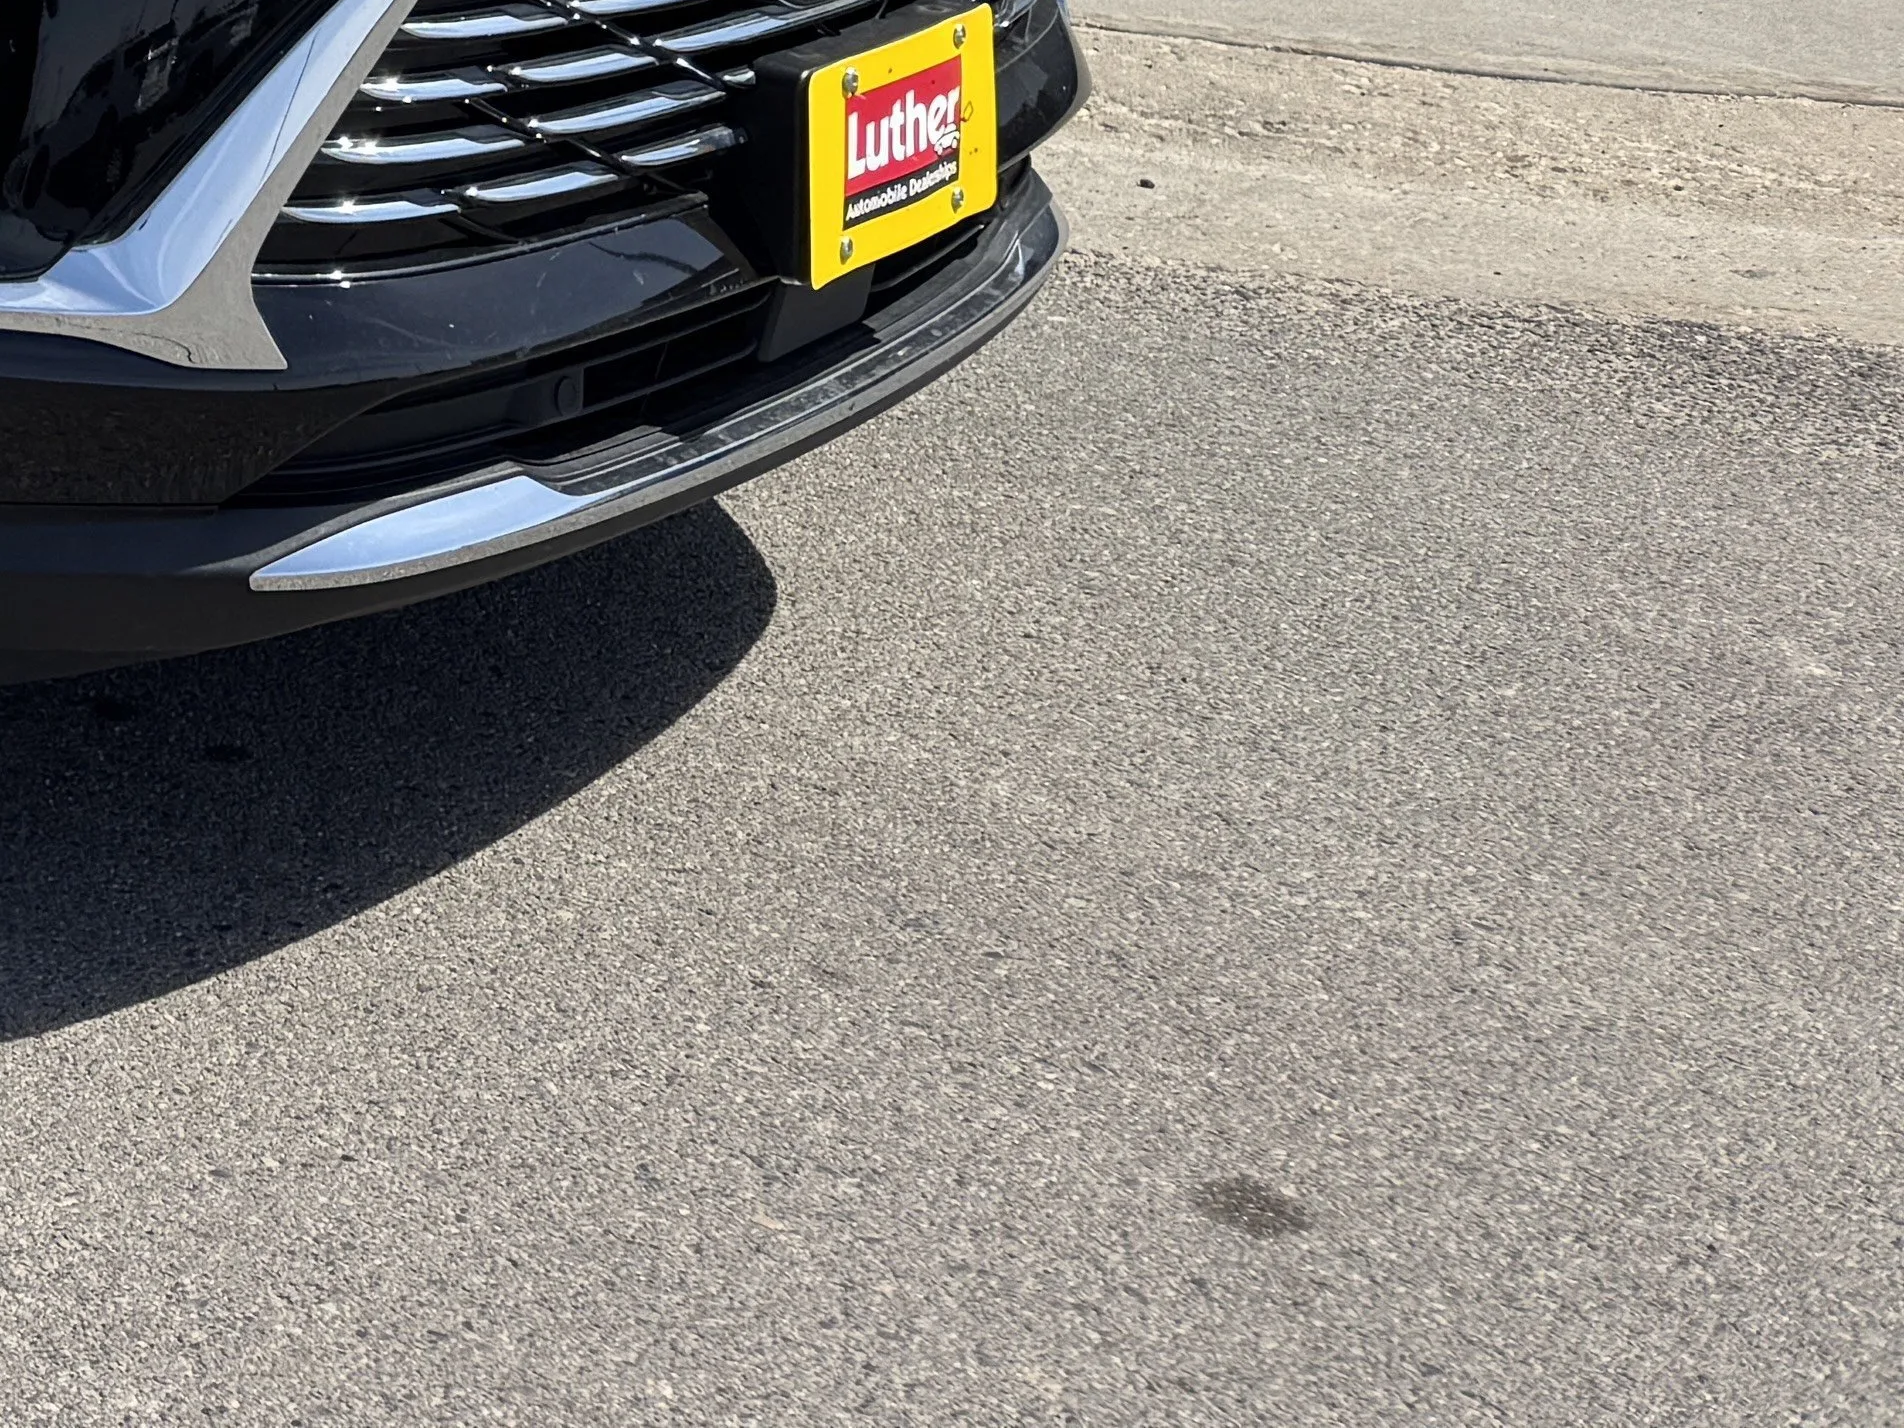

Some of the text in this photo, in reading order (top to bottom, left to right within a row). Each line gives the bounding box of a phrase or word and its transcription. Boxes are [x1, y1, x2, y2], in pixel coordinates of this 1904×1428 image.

[847, 85, 961, 181] Luther
[845, 161, 958, 221] Automobile Dealerships
